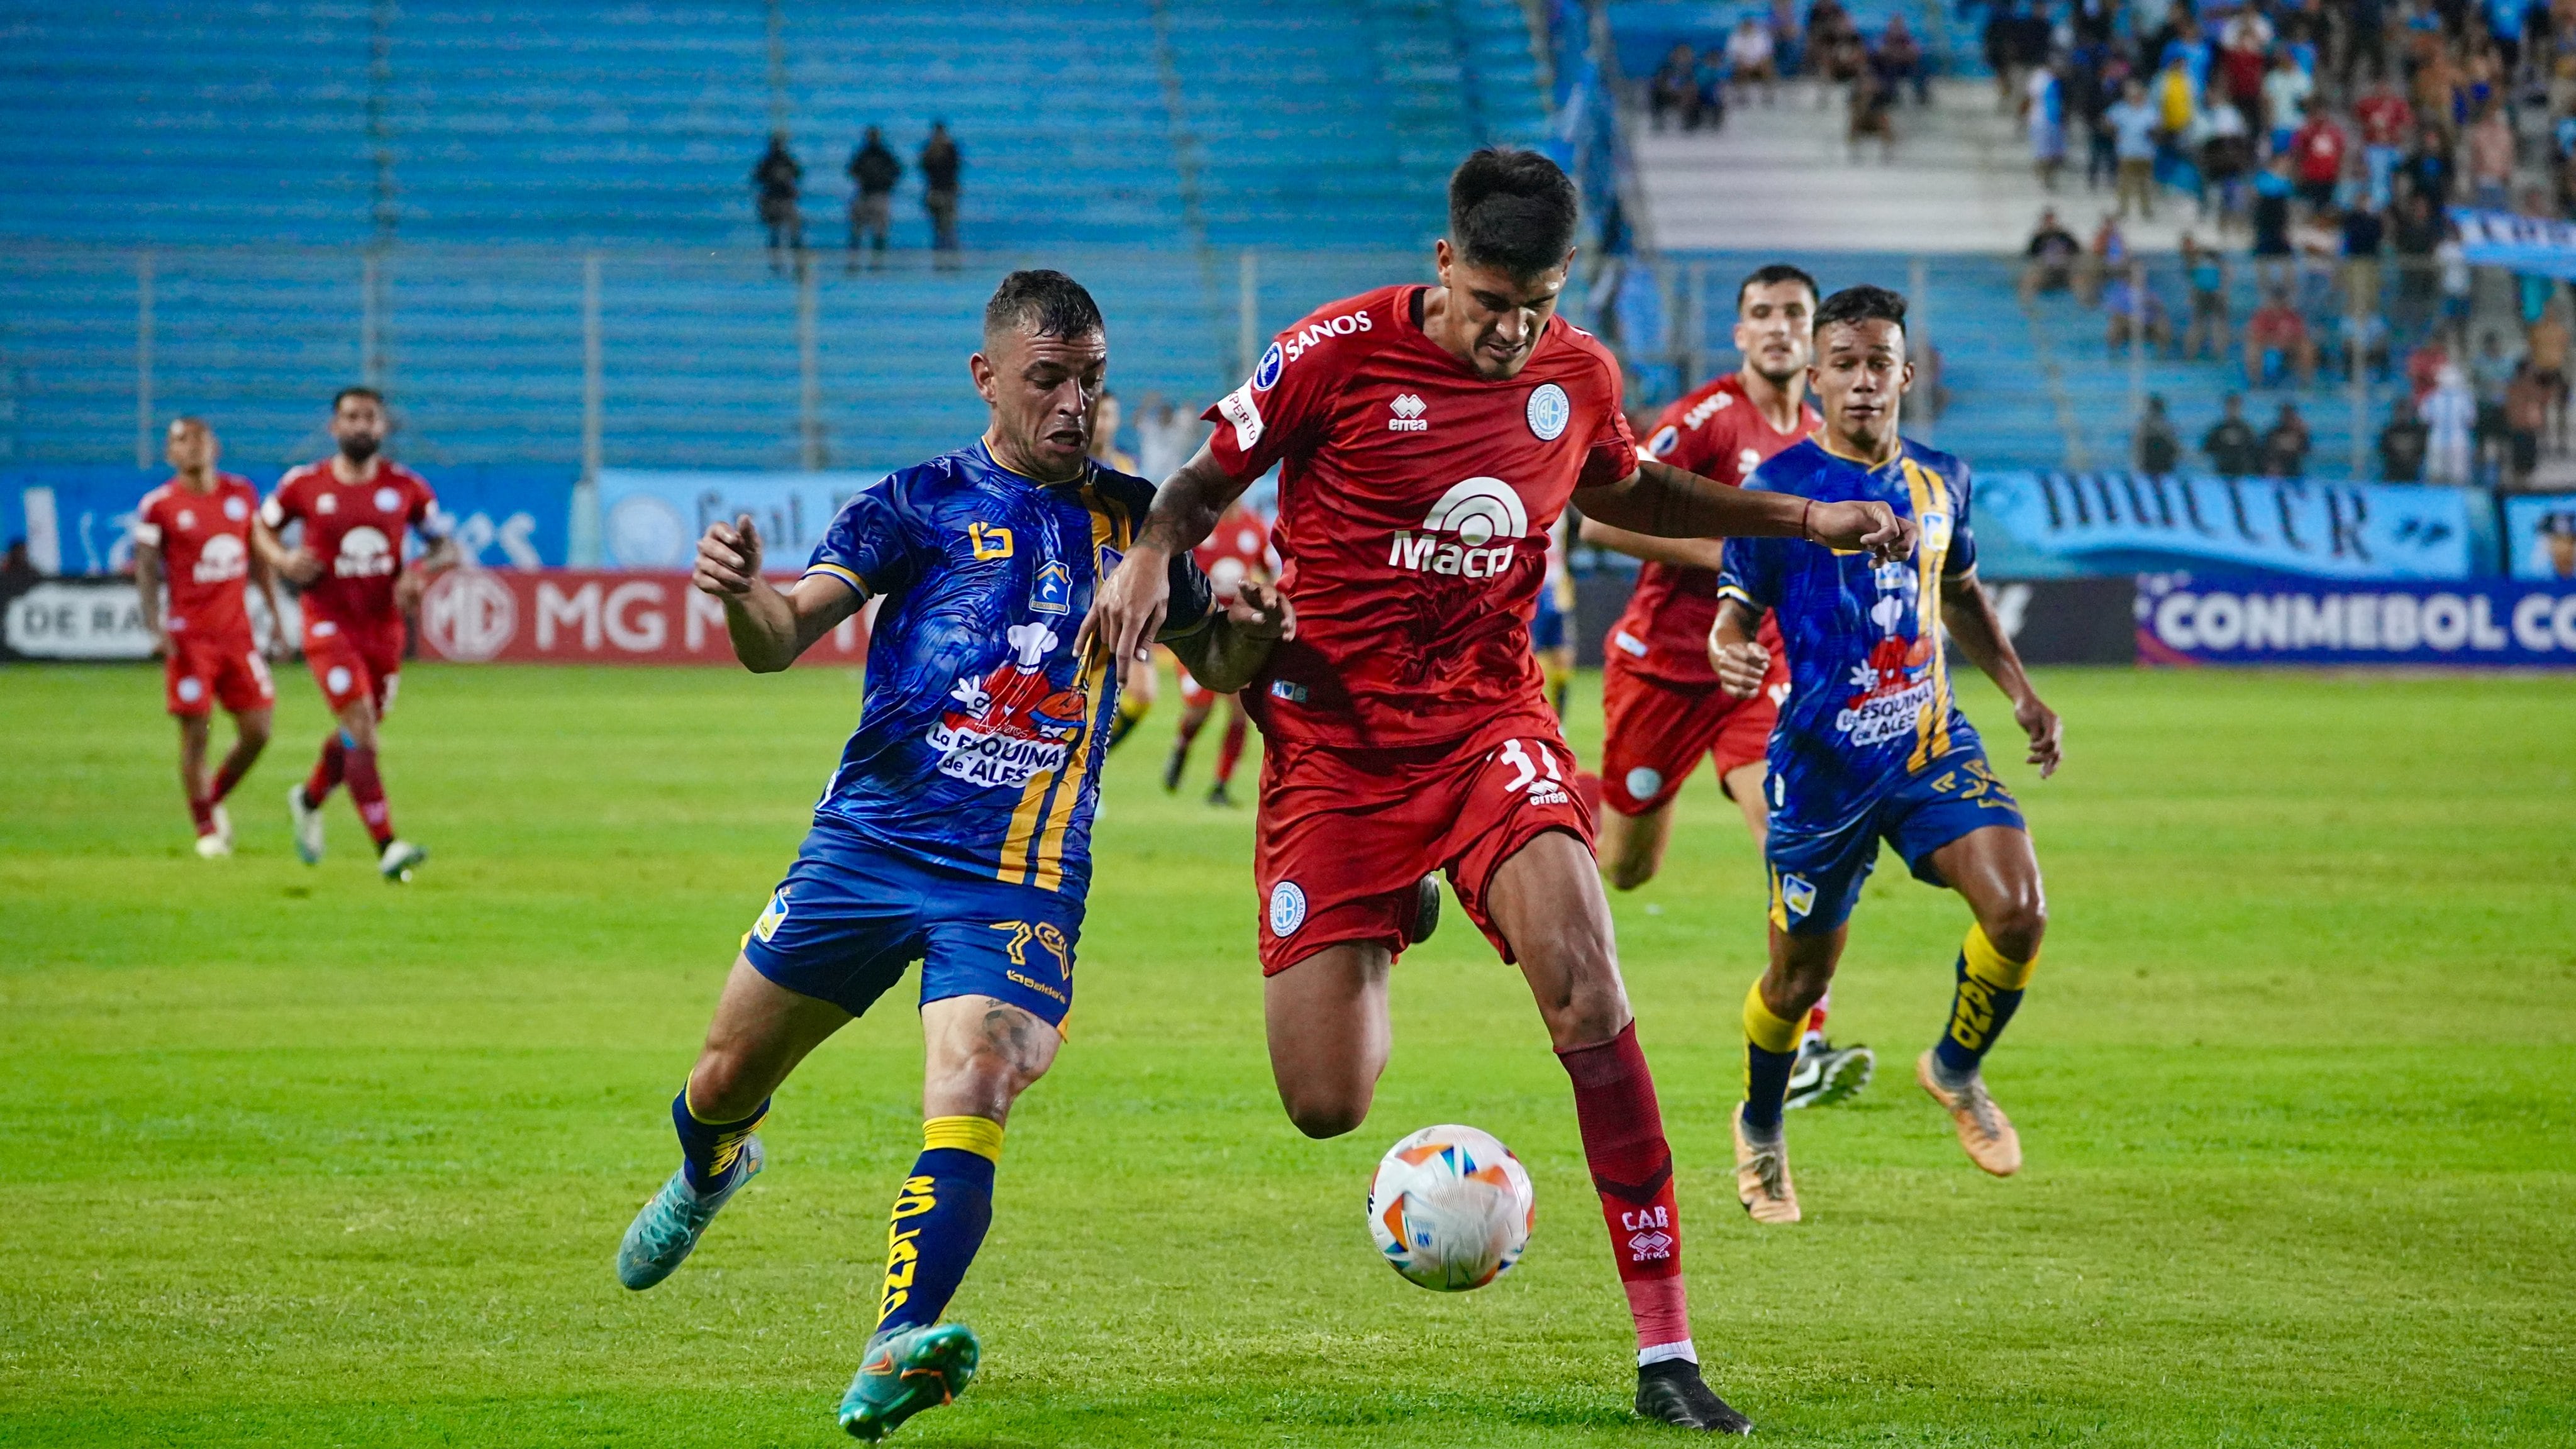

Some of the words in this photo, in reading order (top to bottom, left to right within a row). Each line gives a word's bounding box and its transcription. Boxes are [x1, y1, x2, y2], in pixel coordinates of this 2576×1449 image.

[1284, 310, 1373, 363] SANOS
[536, 582, 667, 652] MG
[2154, 592, 2508, 651] CONMEBOL
[933, 727, 950, 747] La
[943, 756, 963, 772] de
[969, 759, 1030, 783] ALES
[1621, 1205, 1669, 1231] CAB
